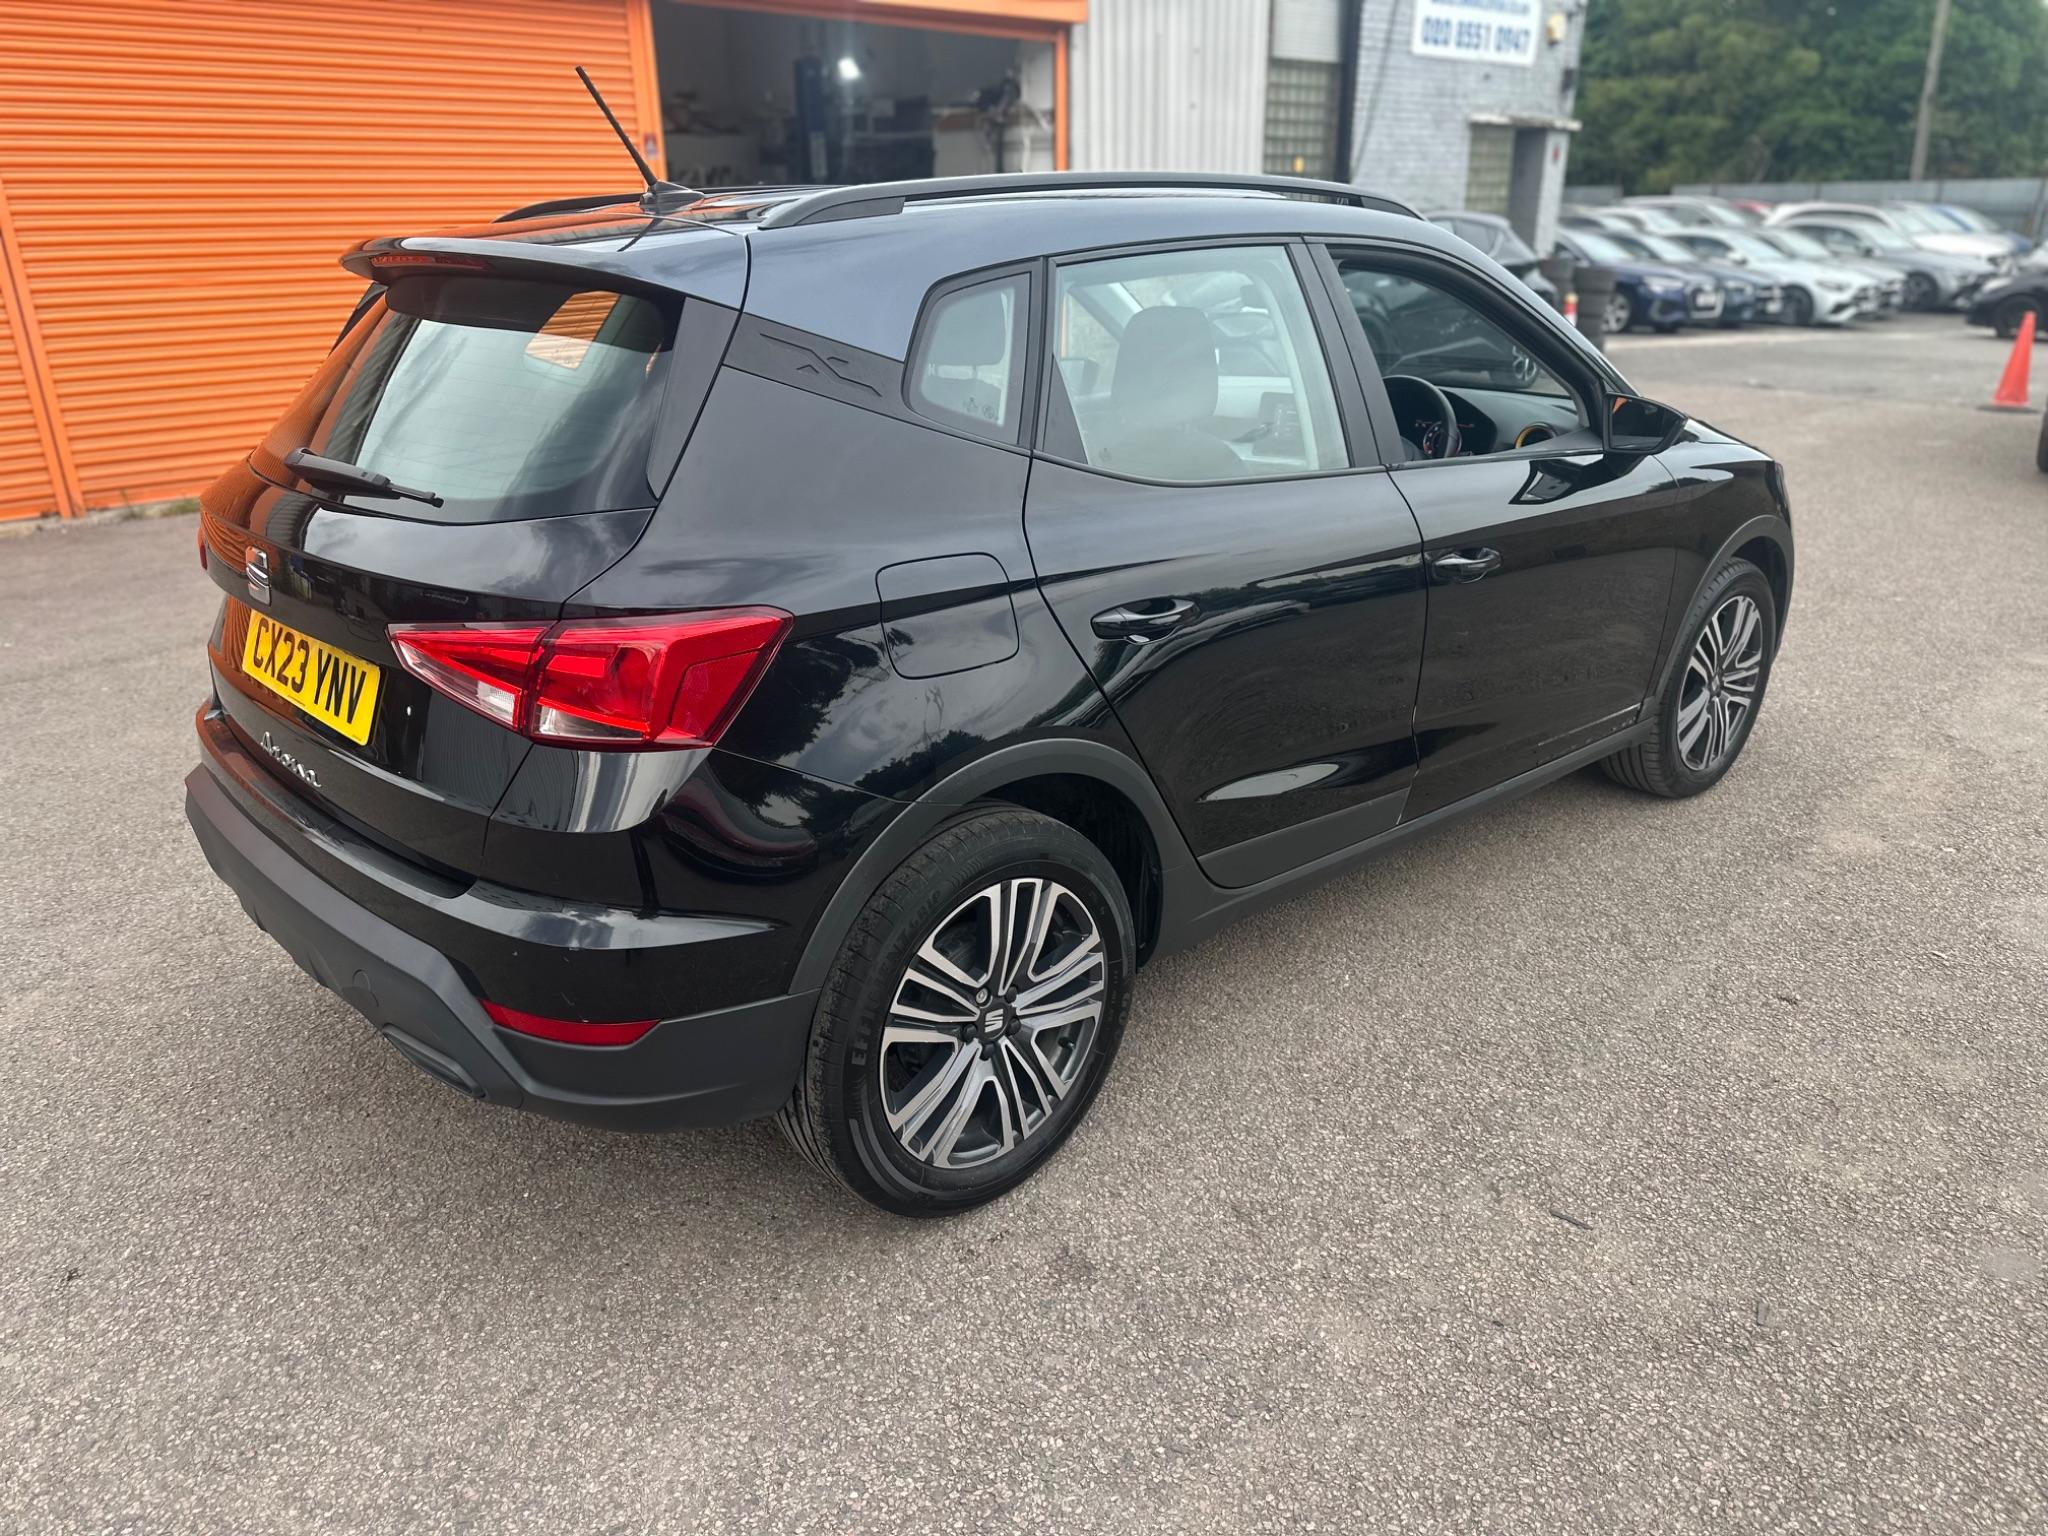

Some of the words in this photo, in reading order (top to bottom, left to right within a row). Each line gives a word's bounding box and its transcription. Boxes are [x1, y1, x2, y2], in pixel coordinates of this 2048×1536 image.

[253, 617, 309, 694] CX23
[314, 648, 367, 724] YNV
[260, 731, 322, 788] Arona
